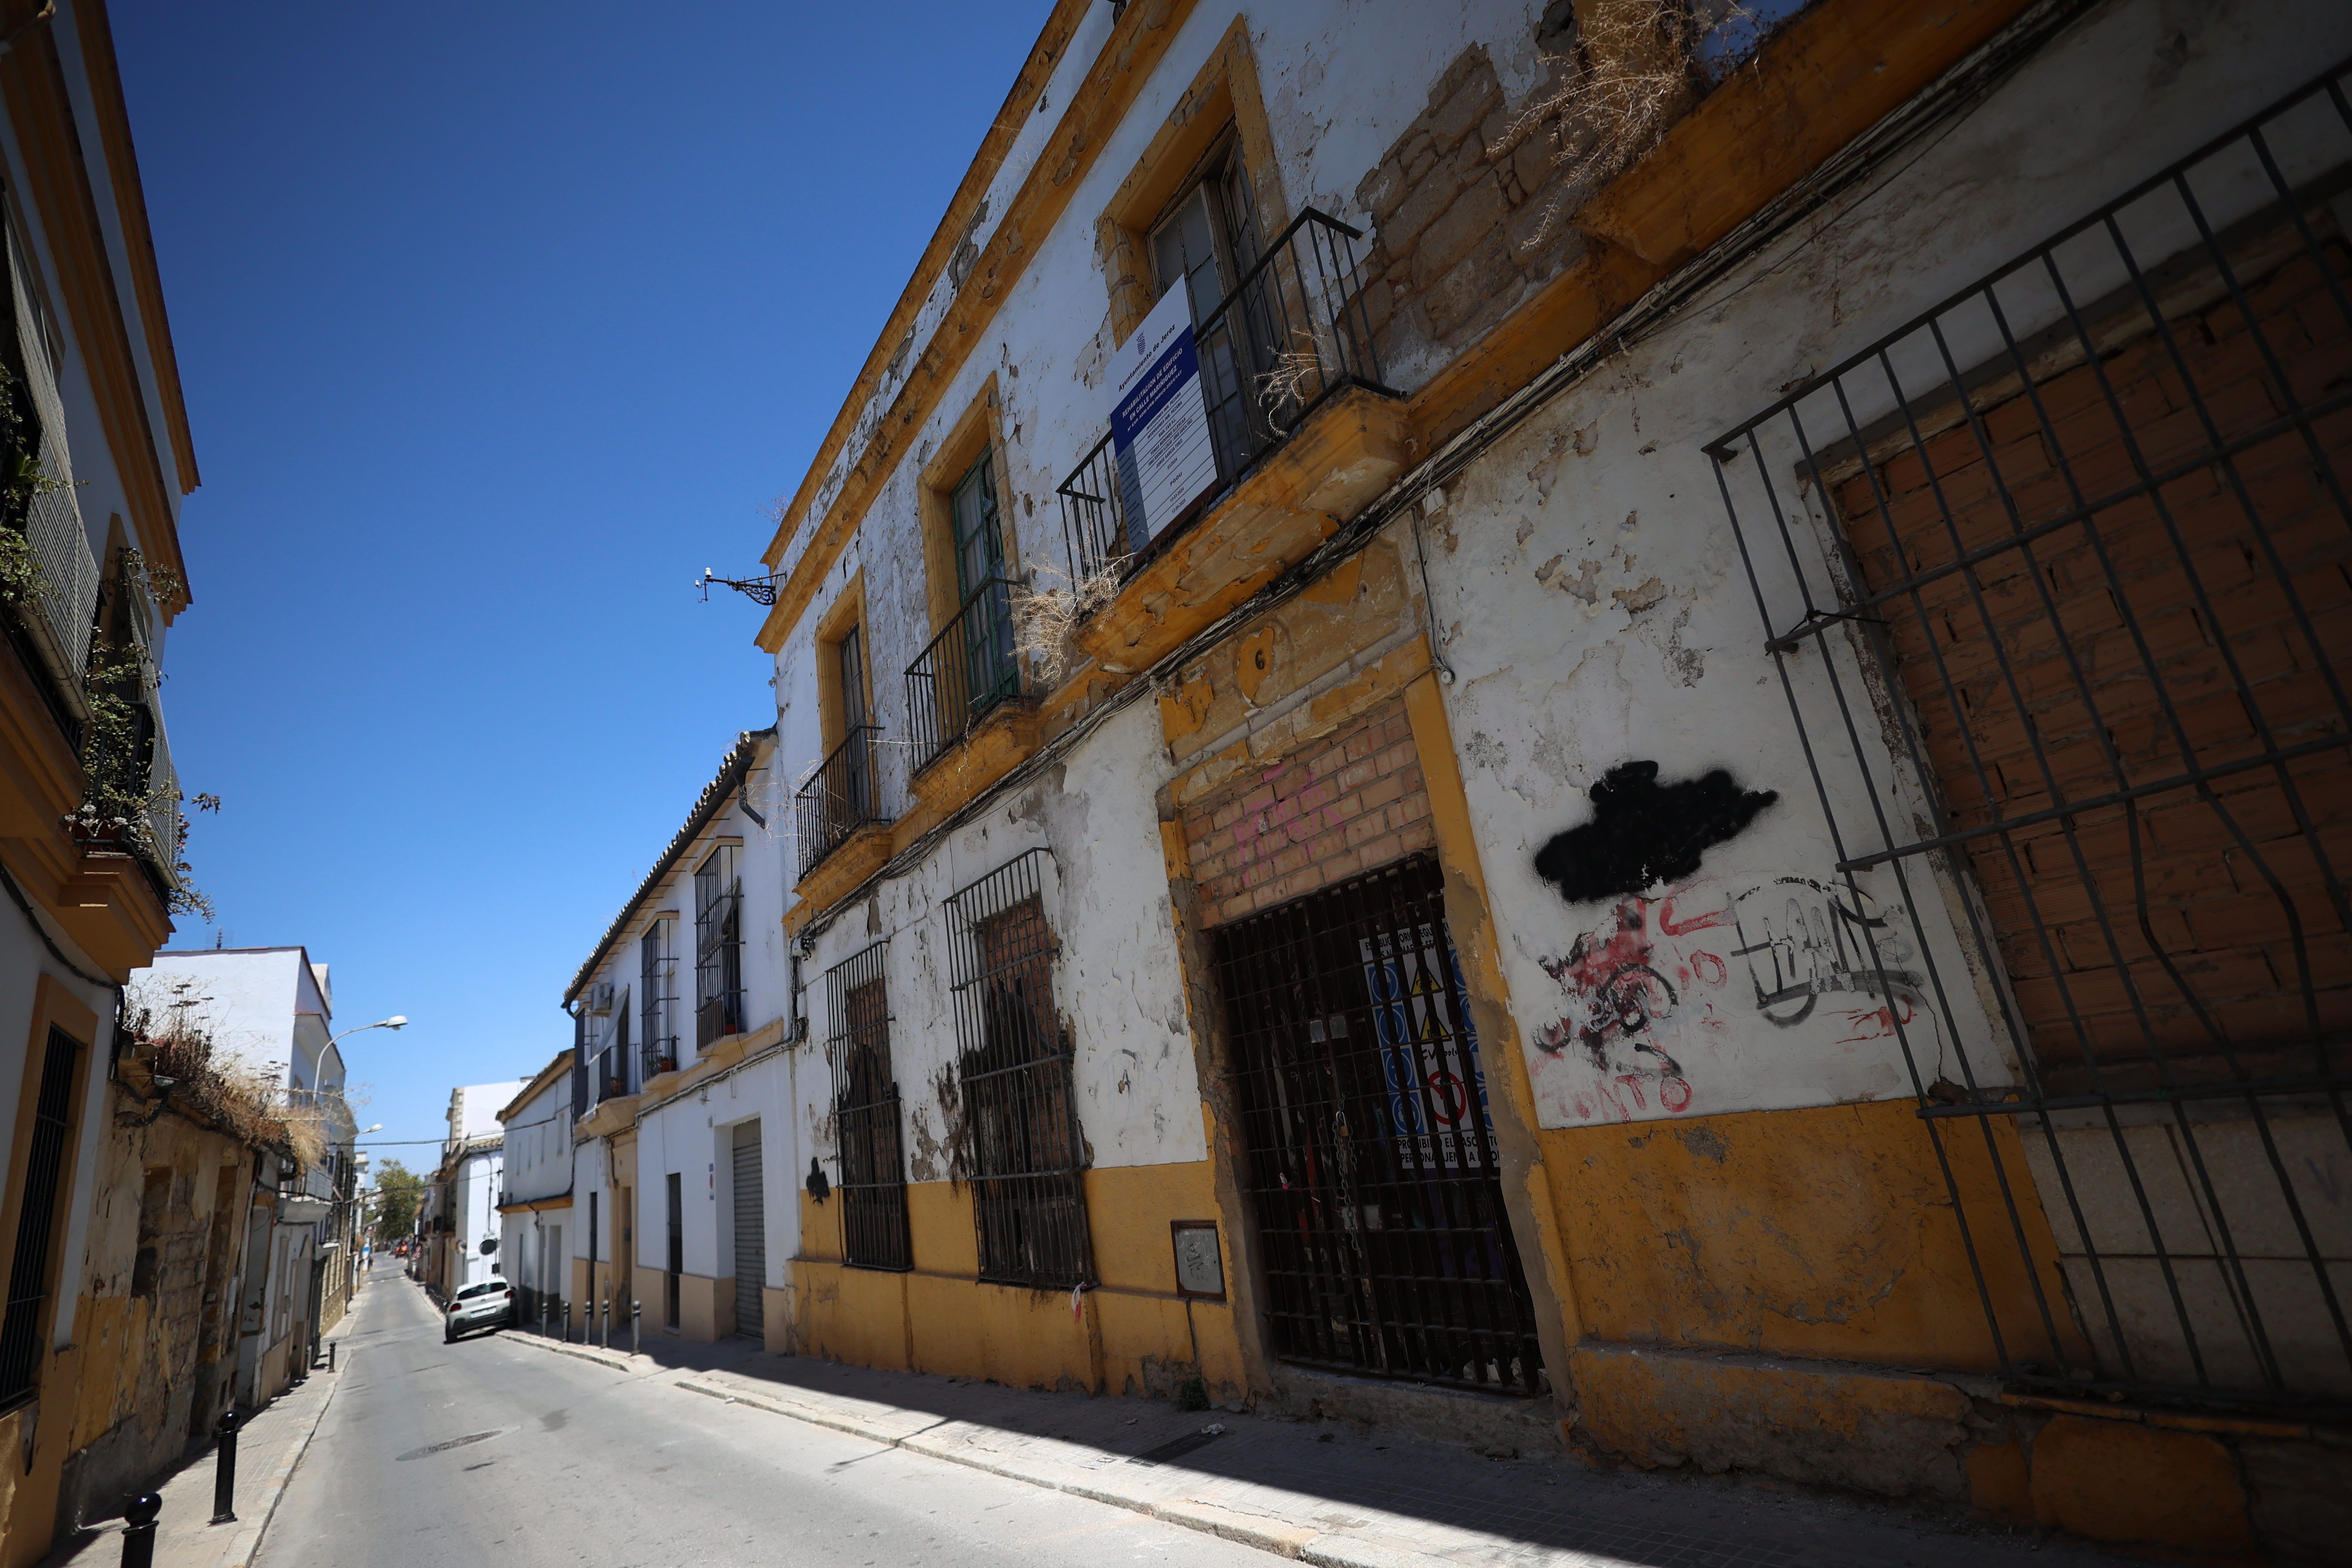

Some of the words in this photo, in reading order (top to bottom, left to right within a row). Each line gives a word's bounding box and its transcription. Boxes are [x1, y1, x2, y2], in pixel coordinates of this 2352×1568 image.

[1118, 351, 1152, 392] Ayuntamiento
[1153, 342, 1159, 352] de
[1161, 324, 1175, 344] Jerez
[1136, 355, 1156, 380] Urbanismo
[1156, 369, 1162, 380] DE
[1163, 346, 1182, 373] EDIFICIO
[1129, 410, 1136, 421] EN
[1136, 395, 1149, 414] CALLE
[1149, 364, 1177, 399] MARIÑIGUEZ
[1146, 410, 1163, 431] INVERSIONES
[1147, 419, 1164, 440] INVERSIONES
[1172, 416, 1185, 433] ILLESCAS
[1170, 471, 1182, 486] PGOU
[1256, 651, 1265, 670] 6
